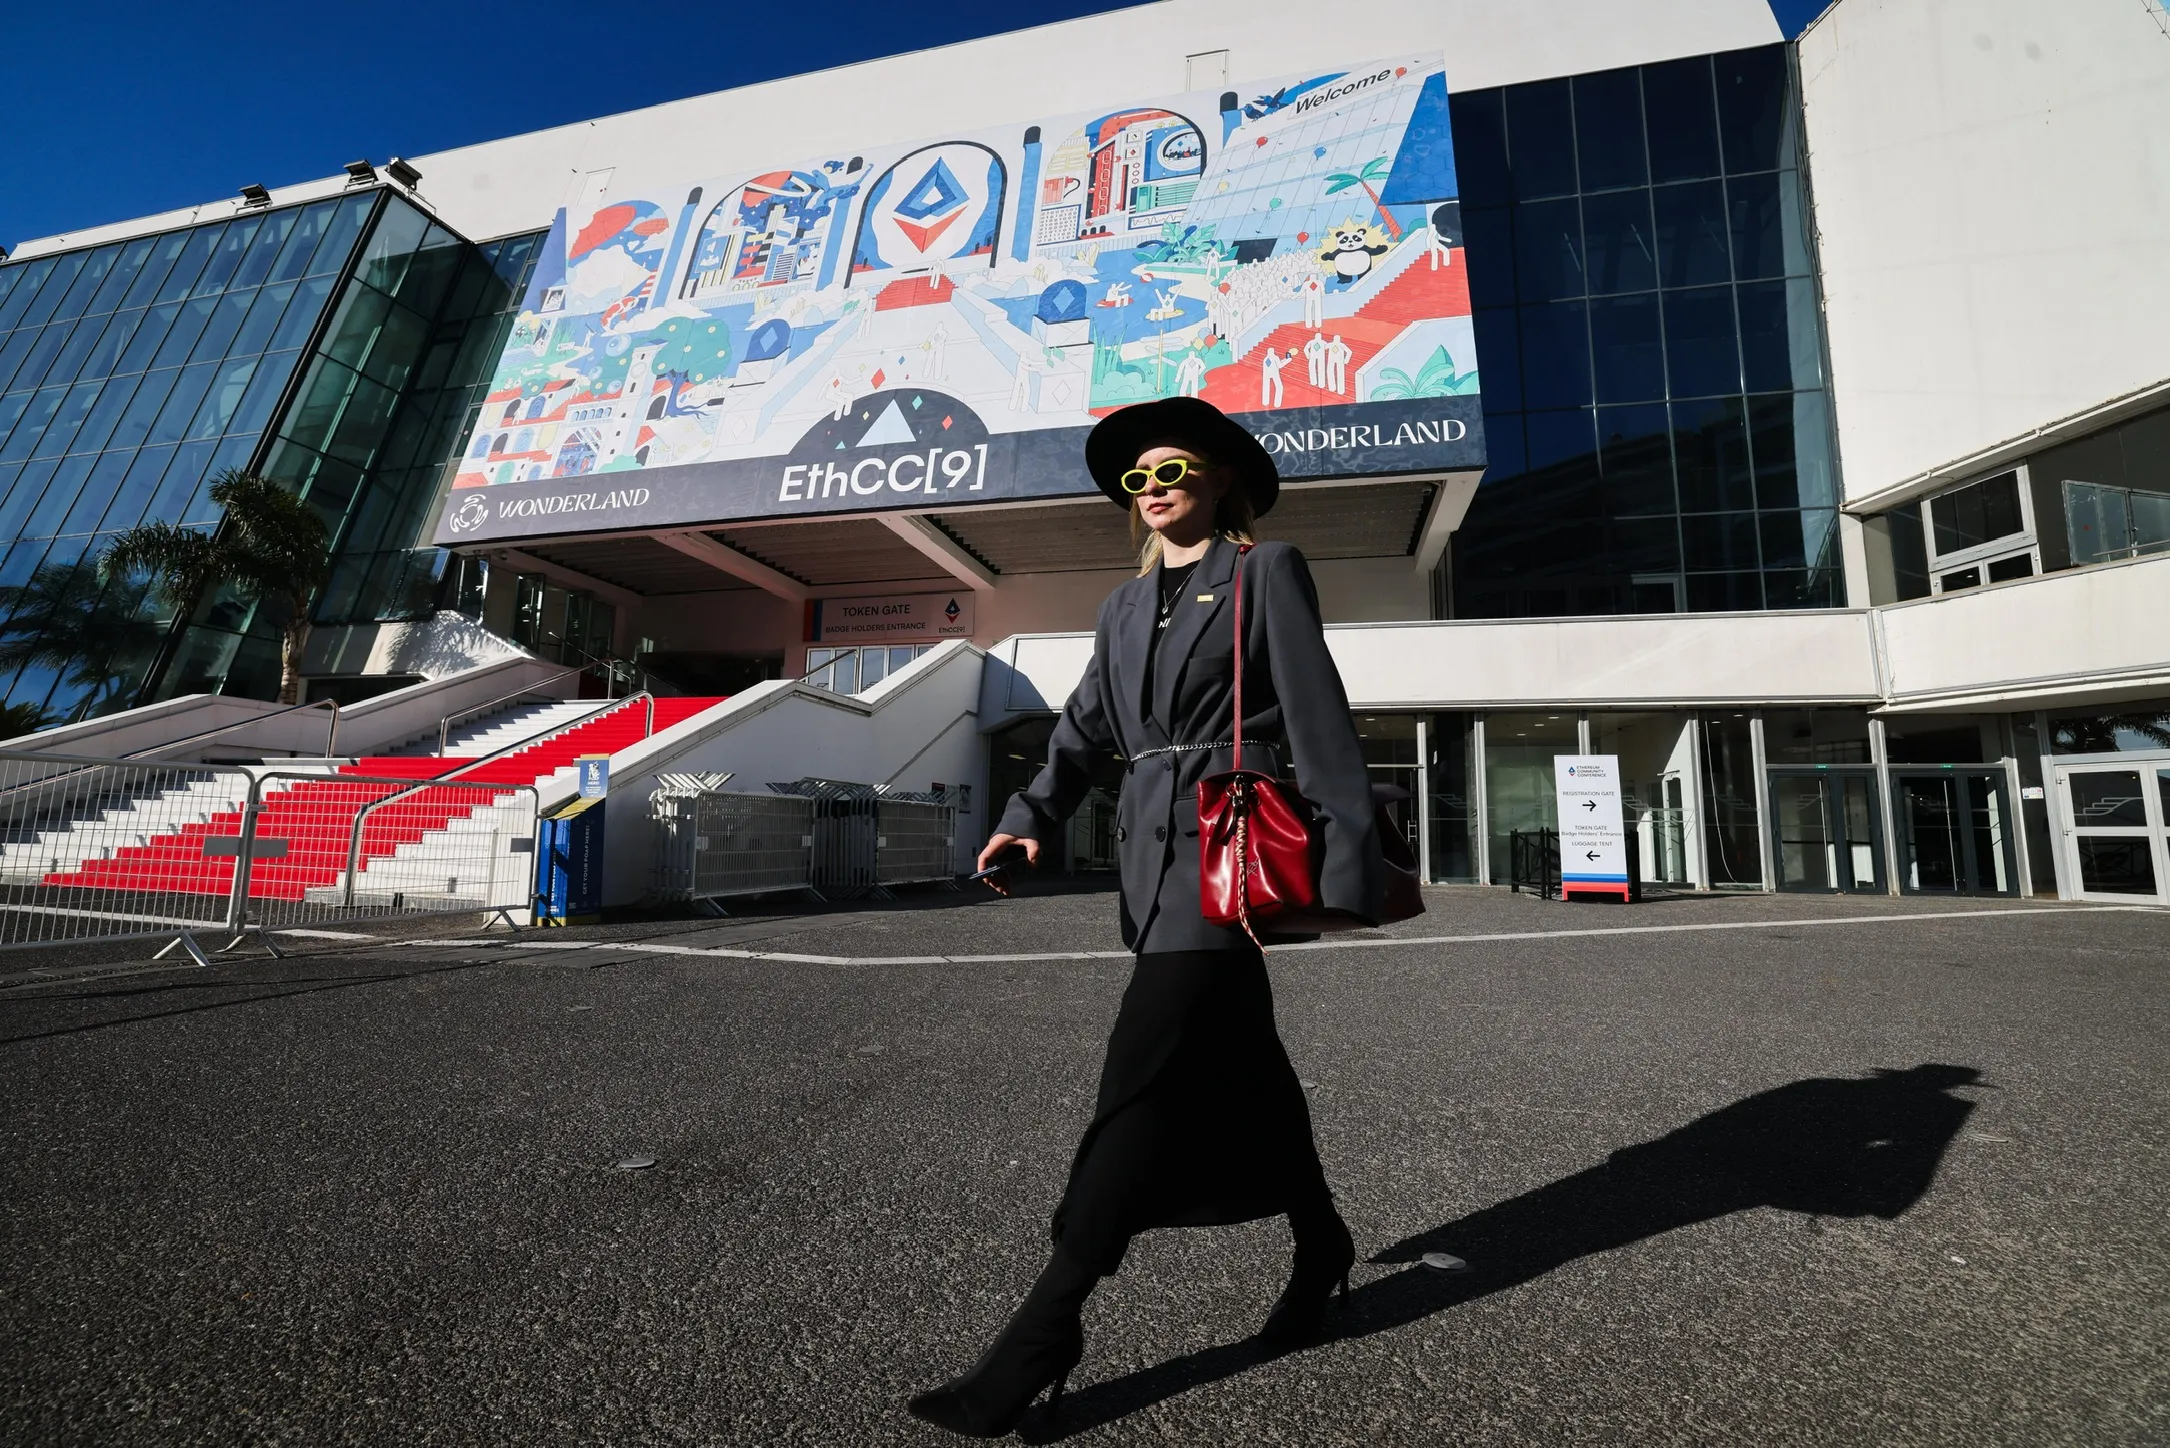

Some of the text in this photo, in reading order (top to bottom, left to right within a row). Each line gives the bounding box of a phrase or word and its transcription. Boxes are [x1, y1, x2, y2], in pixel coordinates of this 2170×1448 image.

[1296, 69, 1391, 114] Welcome
[1254, 419, 1466, 455] ONDERLAND
[779, 443, 988, 502] EthCC[9]
[499, 488, 650, 519] WONDERLAND
[842, 604, 911, 617] TOKEN GATE
[825, 622, 926, 633] BADGE HOLDERS ENTRANCE
